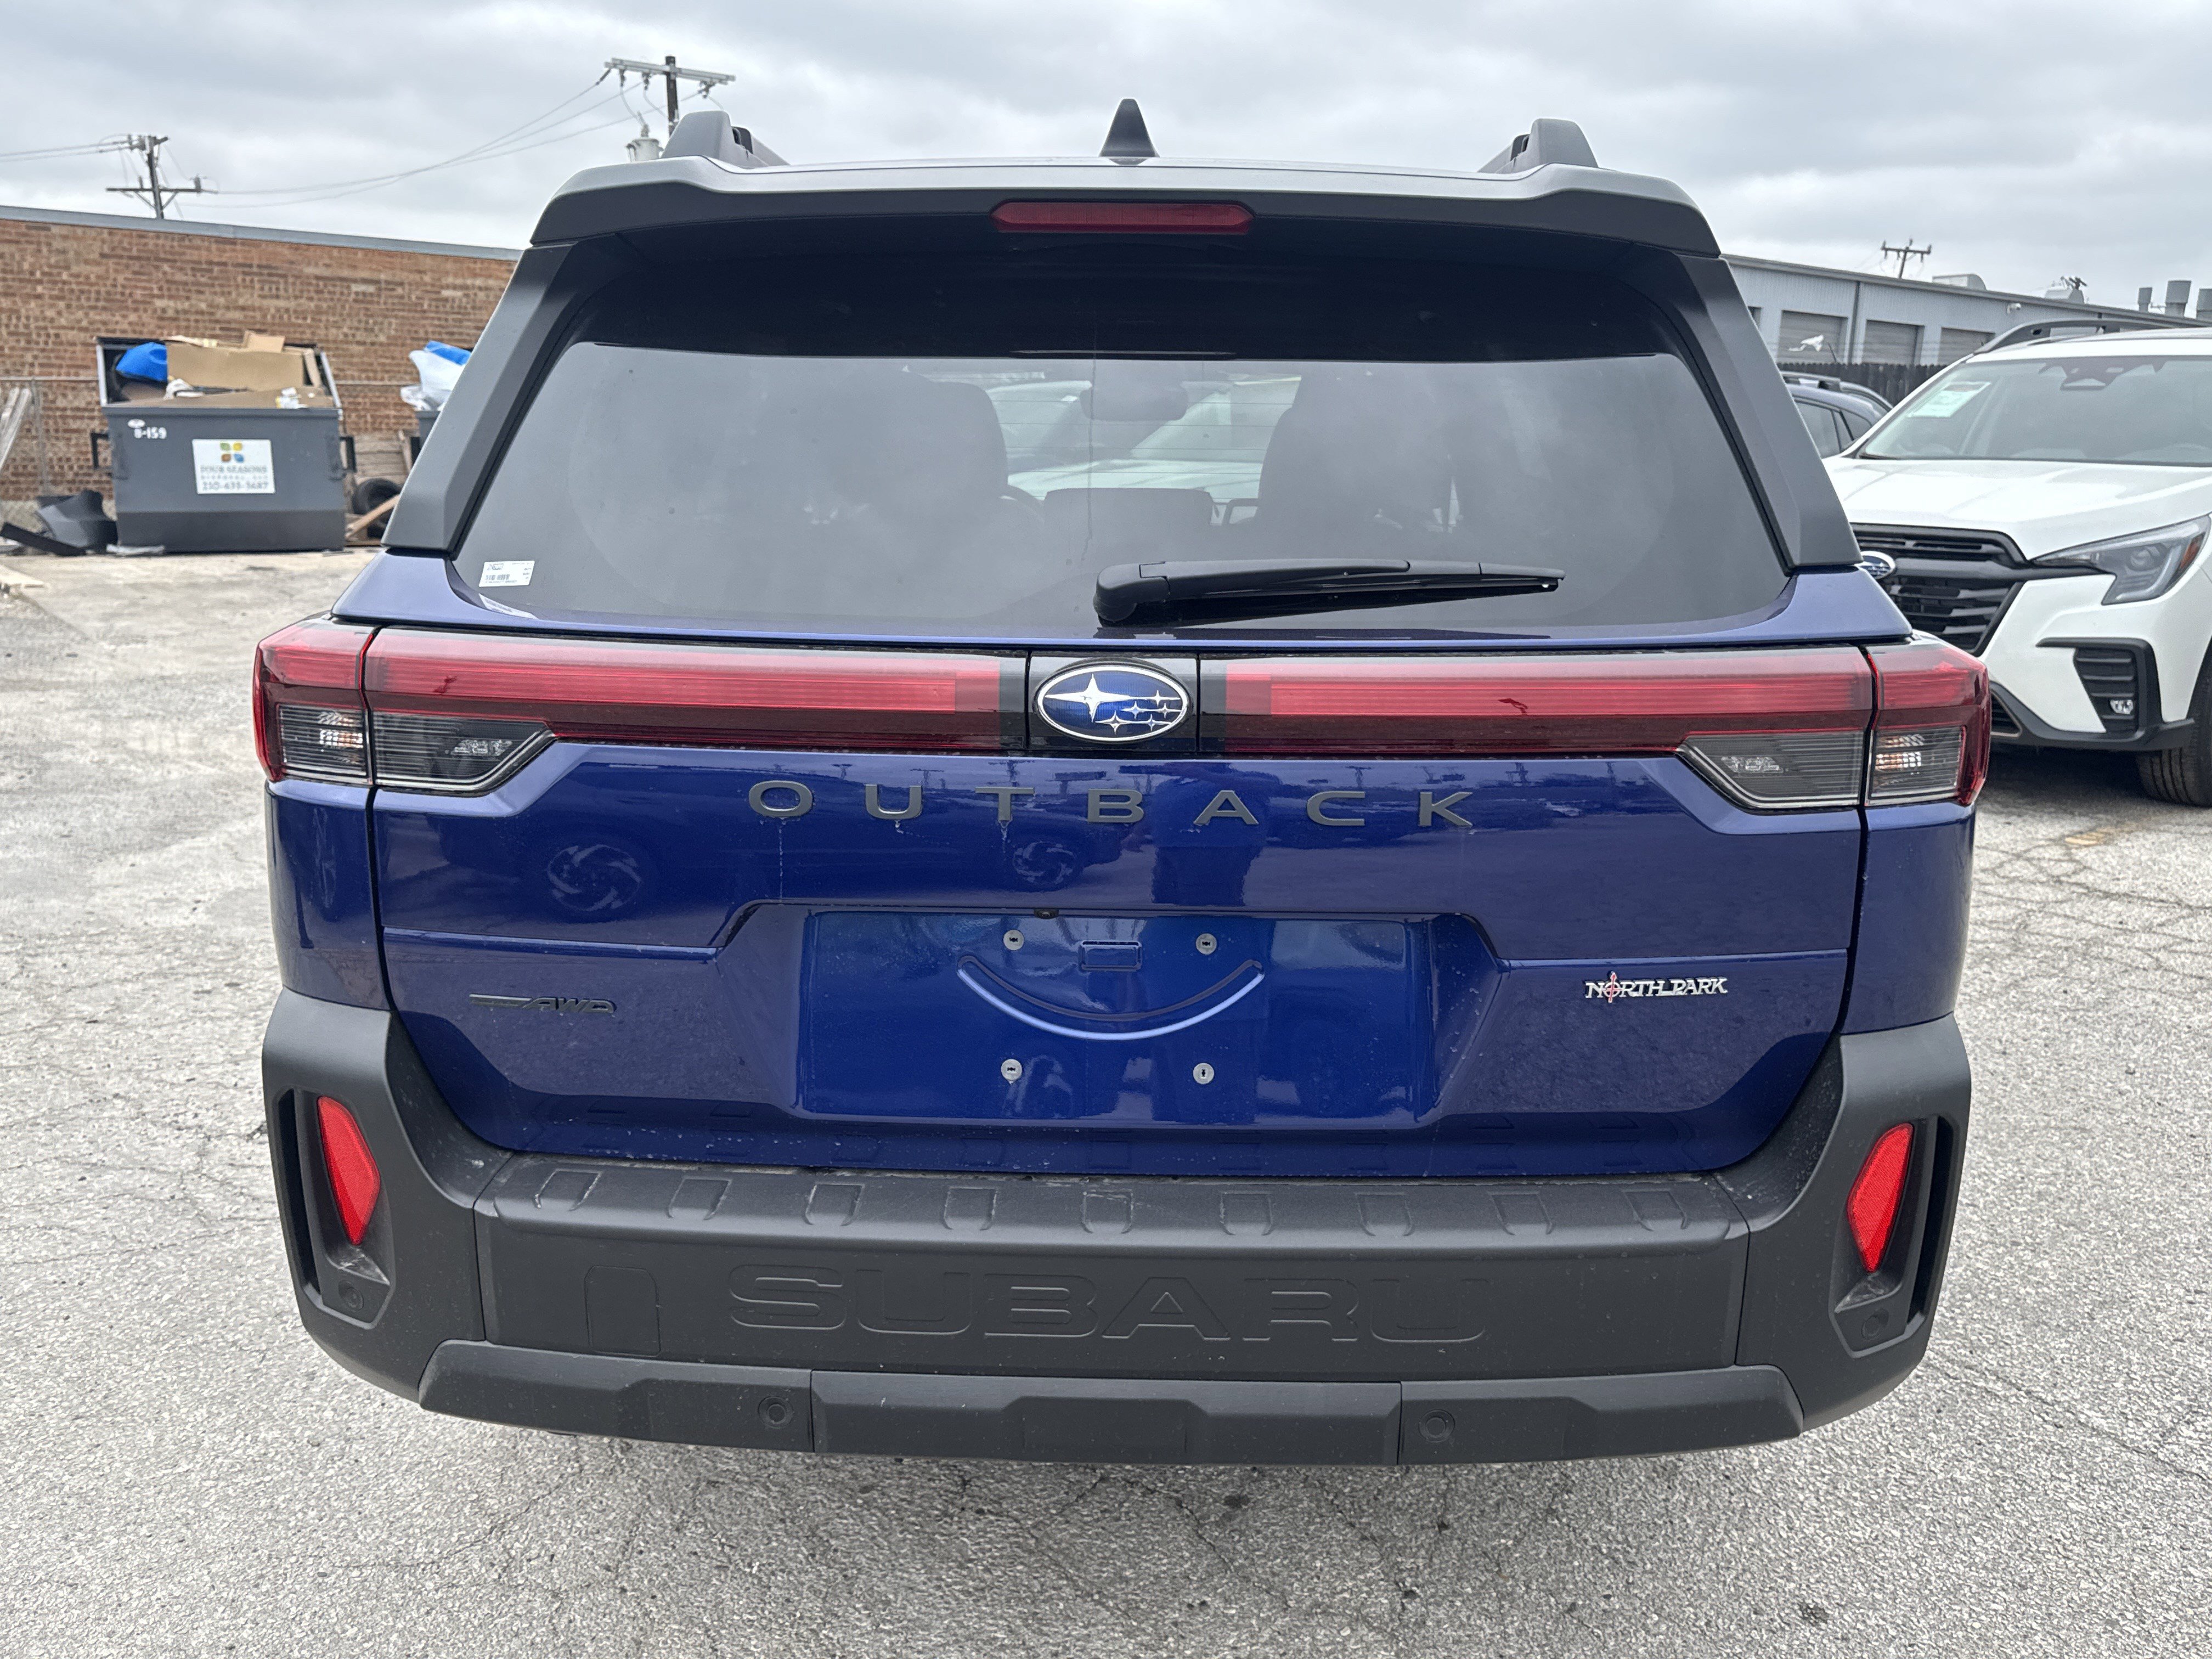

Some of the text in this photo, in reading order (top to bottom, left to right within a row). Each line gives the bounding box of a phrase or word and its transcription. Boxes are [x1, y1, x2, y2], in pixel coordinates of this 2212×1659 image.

[749, 780, 1473, 826] OUTBACK
[1670, 978, 1728, 996] PARK
[523, 997, 616, 1013] AWD
[729, 1263, 1487, 1343] SUBARU
